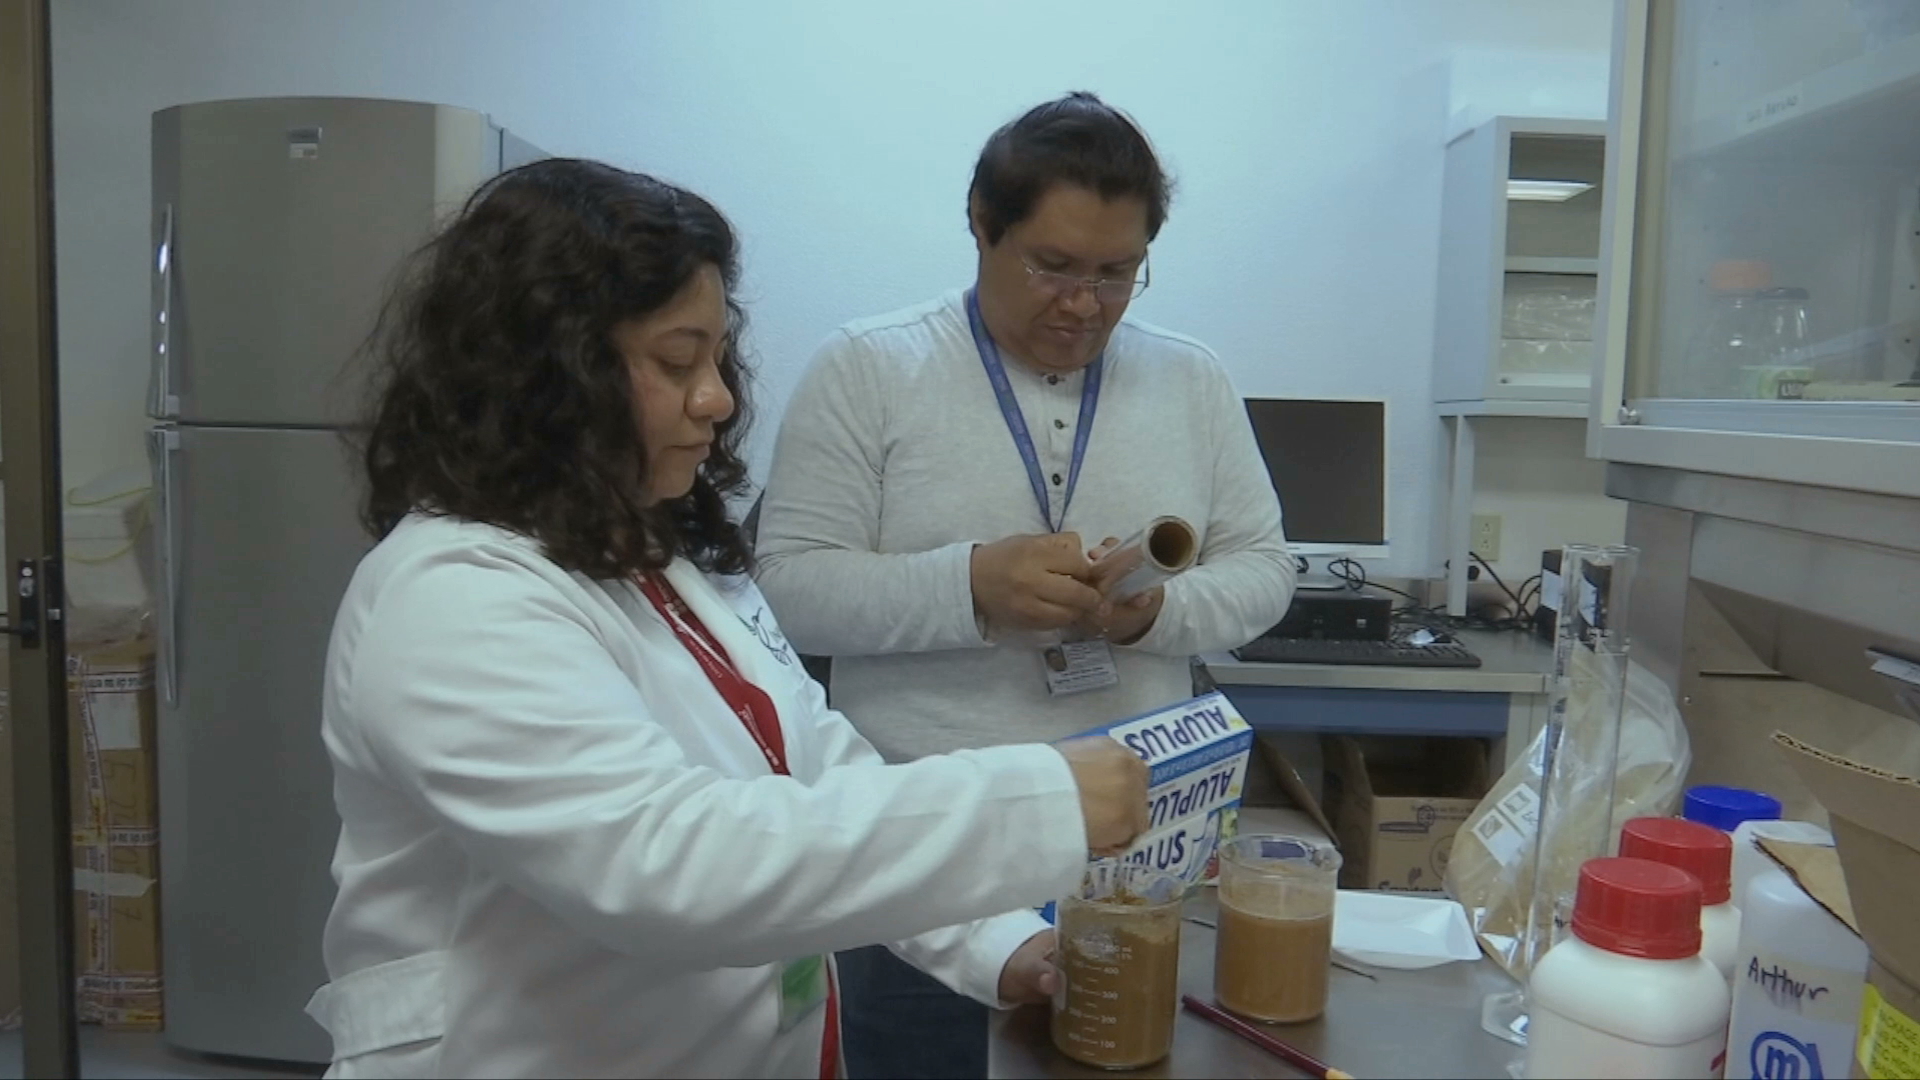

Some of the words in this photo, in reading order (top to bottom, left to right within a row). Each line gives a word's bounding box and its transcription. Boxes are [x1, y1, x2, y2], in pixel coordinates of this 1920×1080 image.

[1124, 705, 1229, 760] ALUPLUS
[1148, 767, 1236, 826] ALUPLU
[1748, 956, 1829, 1000] Arthur
[1099, 1040, 1116, 1049] 100
